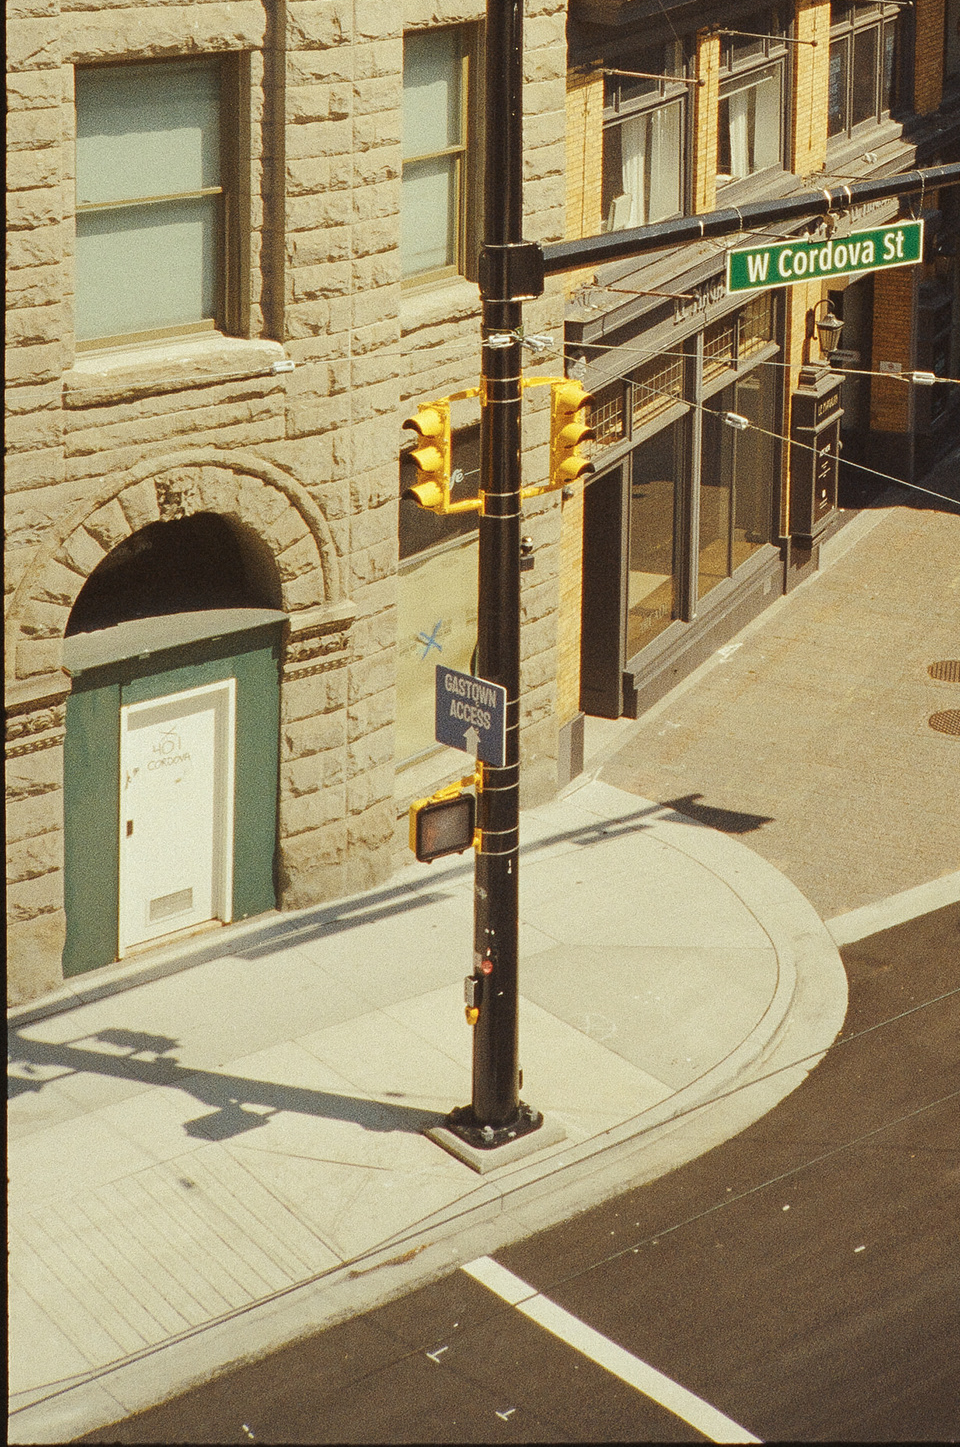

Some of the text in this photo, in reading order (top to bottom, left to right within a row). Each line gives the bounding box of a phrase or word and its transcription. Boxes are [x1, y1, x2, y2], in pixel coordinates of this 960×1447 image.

[747, 231, 904, 283] W Cordova St
[444, 674, 497, 708] GASTOWN
[450, 699, 491, 730] ACCESS
[152, 736, 181, 755] 401
[147, 753, 191, 771] CORDOVA
